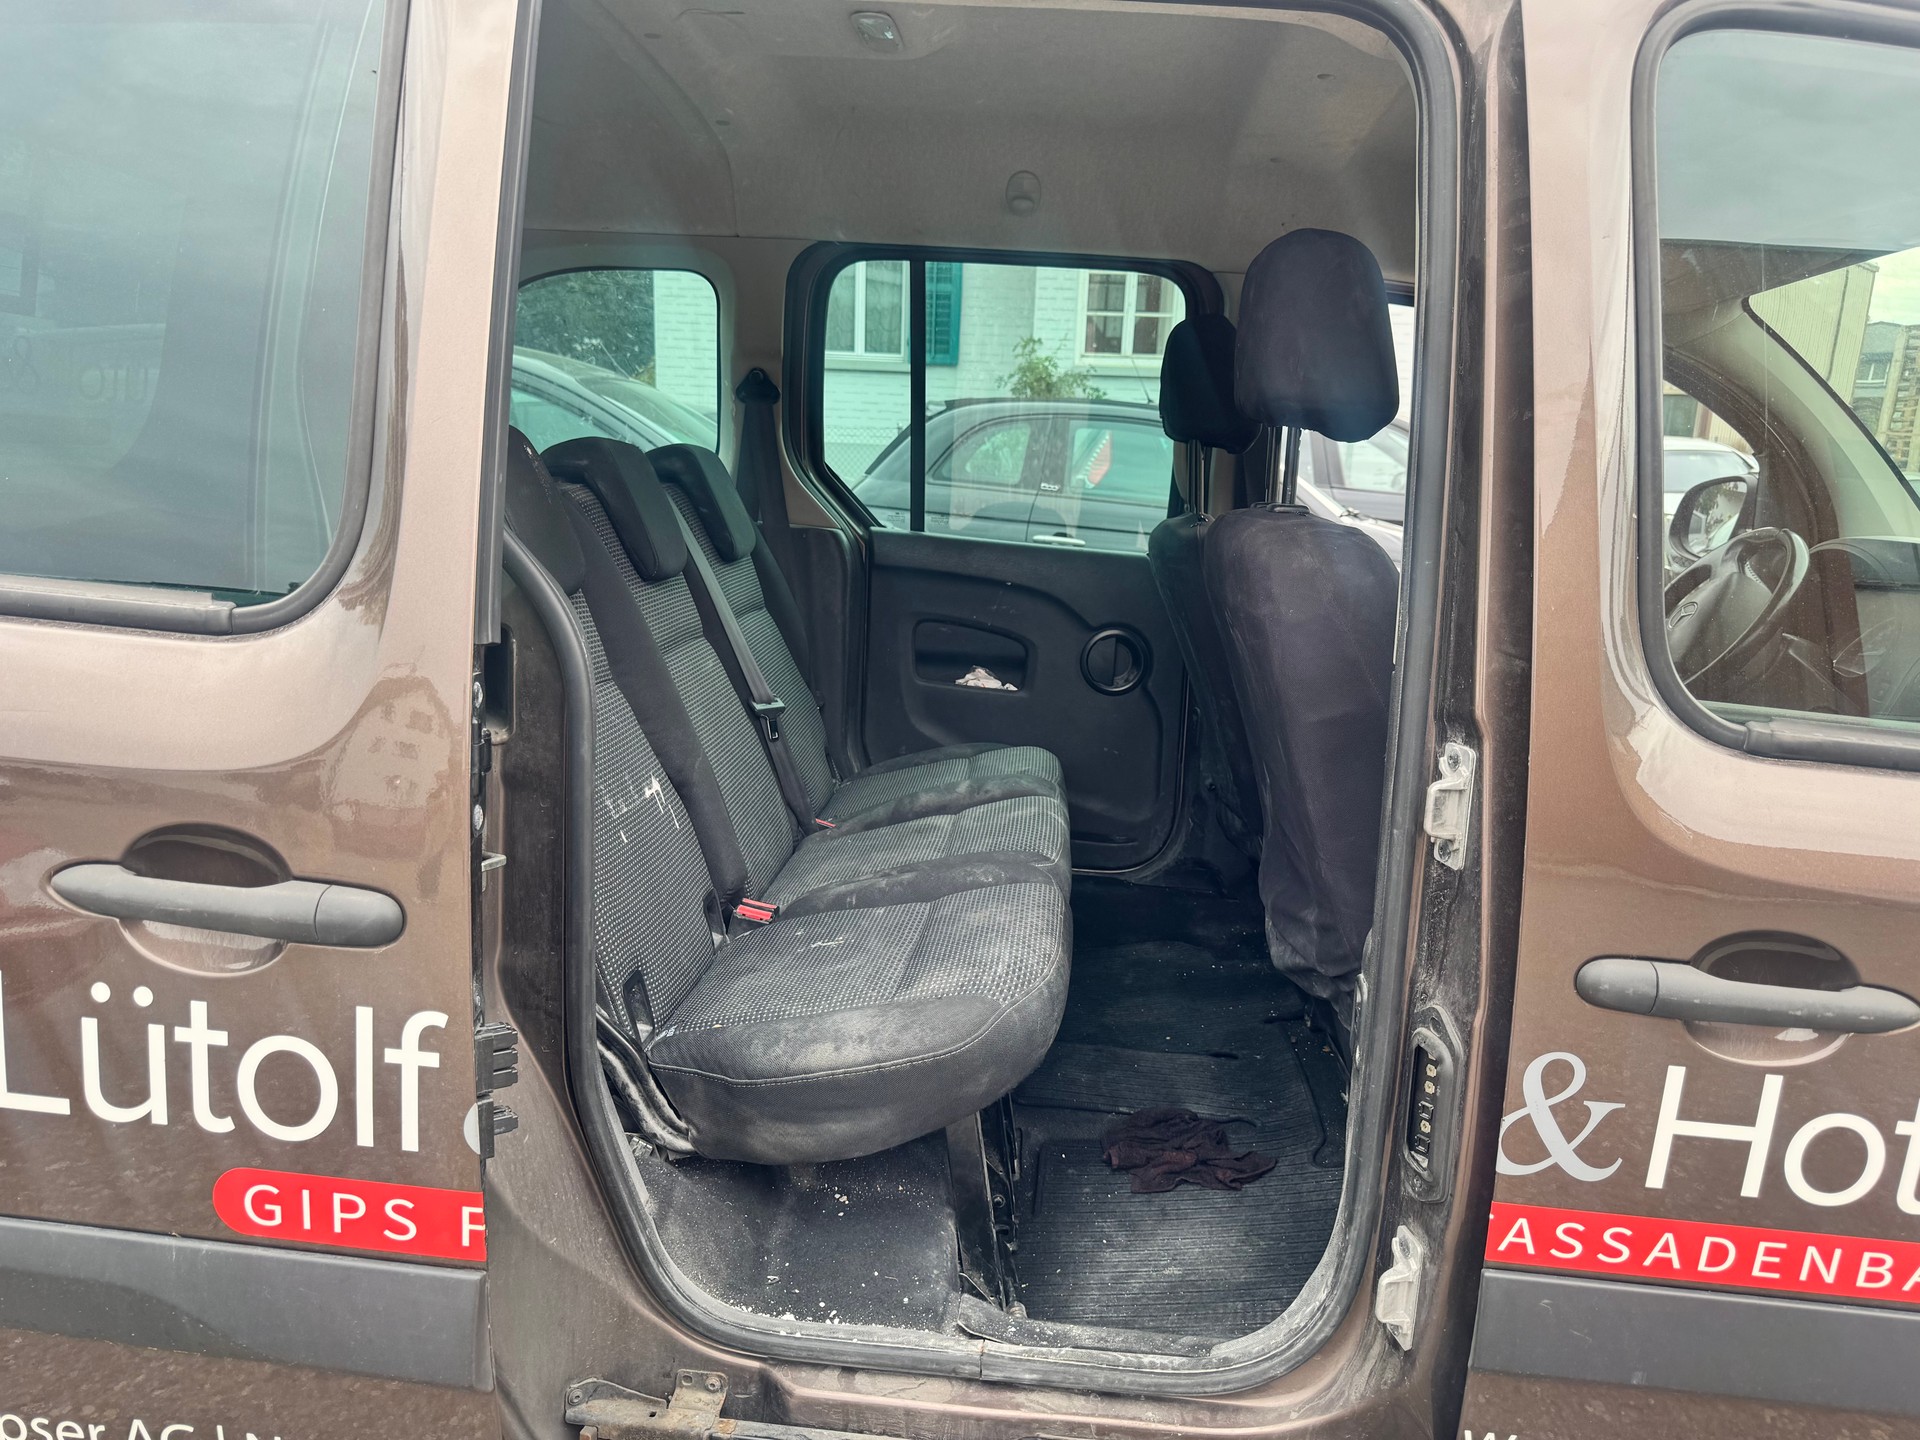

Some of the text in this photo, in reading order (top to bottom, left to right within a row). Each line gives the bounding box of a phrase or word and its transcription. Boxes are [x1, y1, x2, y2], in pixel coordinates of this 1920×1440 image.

[0, 970, 449, 1152] Lütolf
[1495, 1052, 1920, 1216] & Hot
[243, 1184, 417, 1241] GIPS
[1489, 1213, 1920, 1292] ASSADENB
